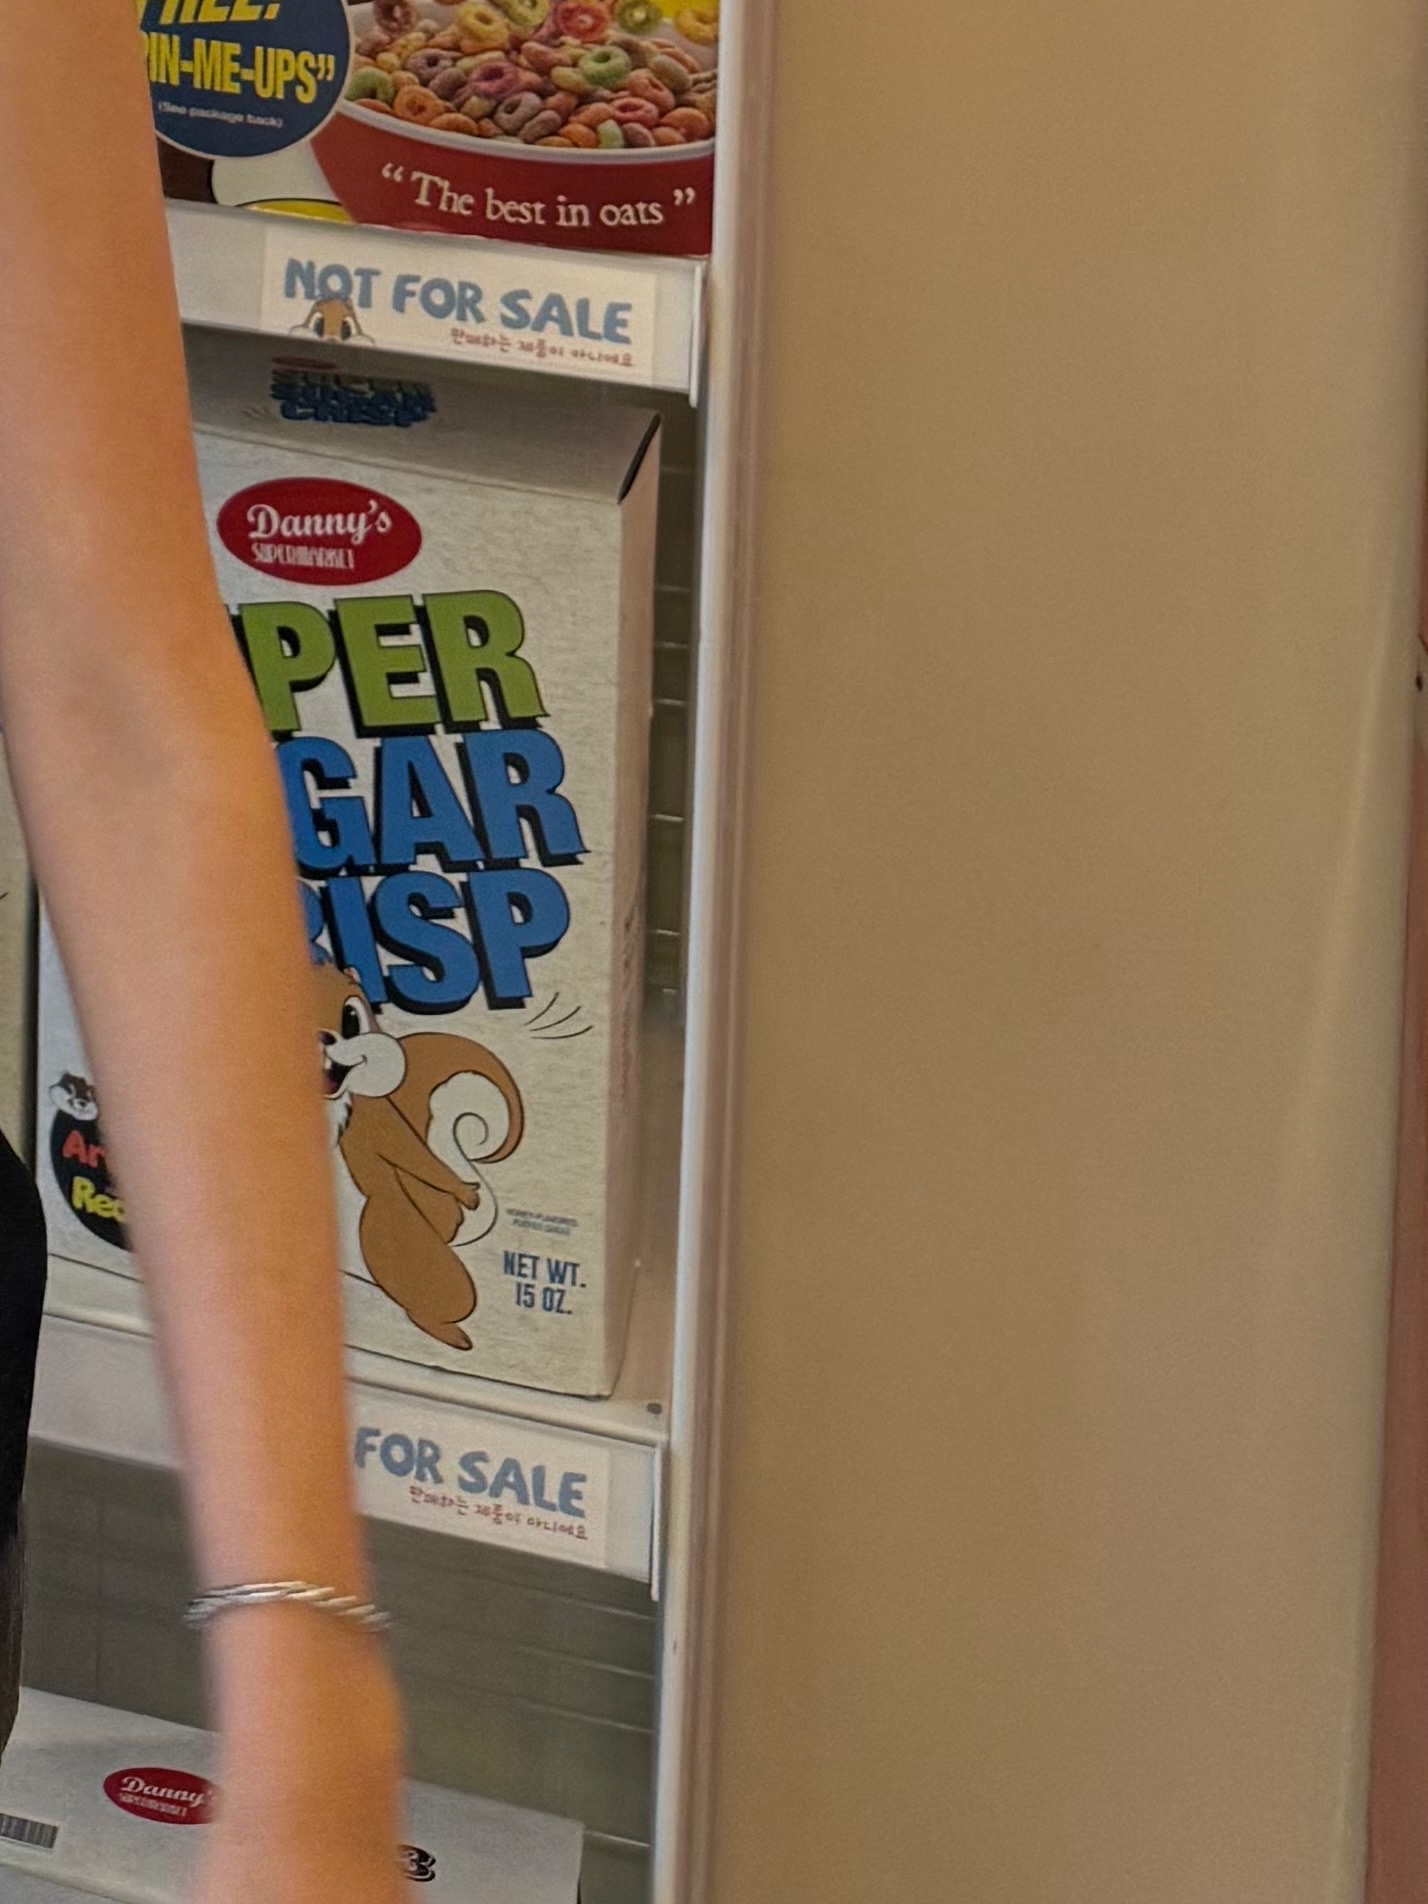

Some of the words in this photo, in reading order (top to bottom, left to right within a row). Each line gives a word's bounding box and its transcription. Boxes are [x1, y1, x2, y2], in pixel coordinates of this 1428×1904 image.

[142, 31, 335, 104] IN-ME-UPS”
[485, 188, 545, 223] best
[554, 195, 590, 225] in
[284, 258, 381, 309] NOT
[392, 274, 485, 323] FOR
[500, 289, 632, 344] SALE
[248, 494, 391, 551] Danny's
[233, 590, 548, 738] PER
[280, 728, 587, 875] GAR
[307, 866, 570, 1013] ISP
[504, 1251, 540, 1280] NET
[547, 1258, 586, 1288] WT.
[516, 1283, 535, 1308] 15
[543, 1287, 572, 1314] OZ.
[354, 1426, 443, 1483] FOR
[456, 1451, 586, 1517] SALE
